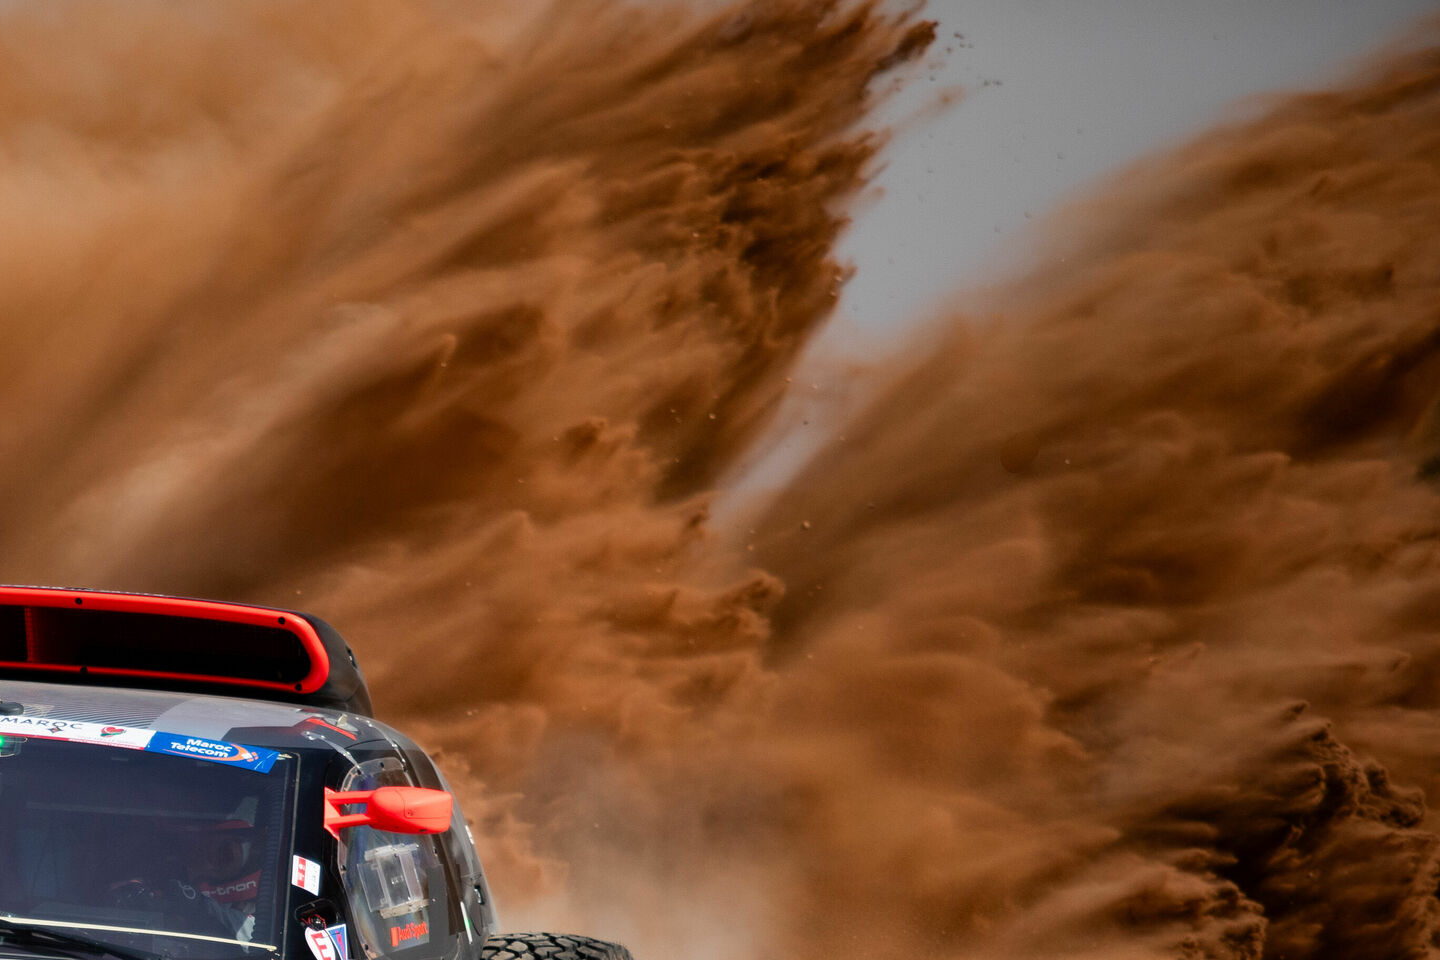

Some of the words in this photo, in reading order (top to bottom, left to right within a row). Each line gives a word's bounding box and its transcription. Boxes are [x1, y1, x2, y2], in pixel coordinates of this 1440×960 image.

[1, 717, 83, 730] MAROC
[170, 742, 229, 758] Telecom
[186, 738, 233, 753] Maroc
[398, 924, 411, 942] Audi
[410, 921, 429, 941] Sport
